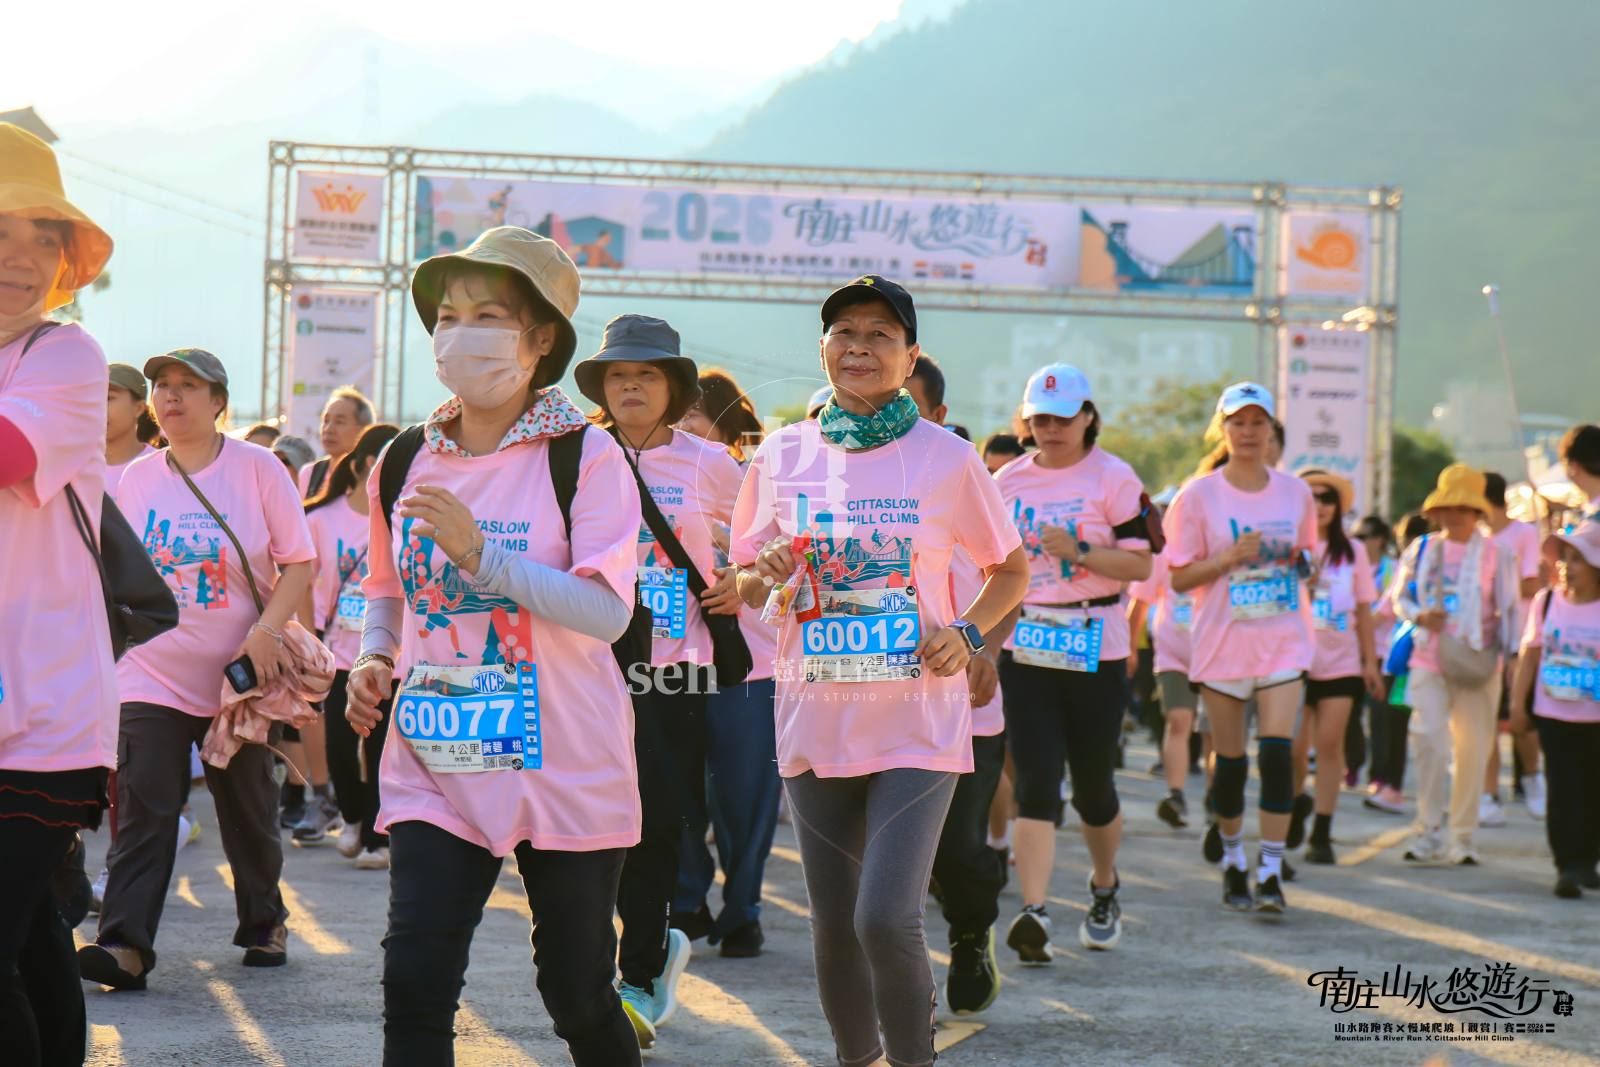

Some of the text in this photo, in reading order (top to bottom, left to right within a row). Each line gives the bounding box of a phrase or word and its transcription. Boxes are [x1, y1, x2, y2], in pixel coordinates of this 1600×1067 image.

[641, 191, 774, 245] 2026
[647, 486, 684, 494] ASLOW
[847, 498, 919, 511] CITTASLOW
[180, 512, 229, 521] CITTASLW
[847, 513, 920, 525] HILL CLIMB
[475, 520, 530, 533] ASLOW
[807, 618, 916, 652] 60012
[1018, 626, 1087, 653] 60136
[398, 700, 515, 738] 60077
